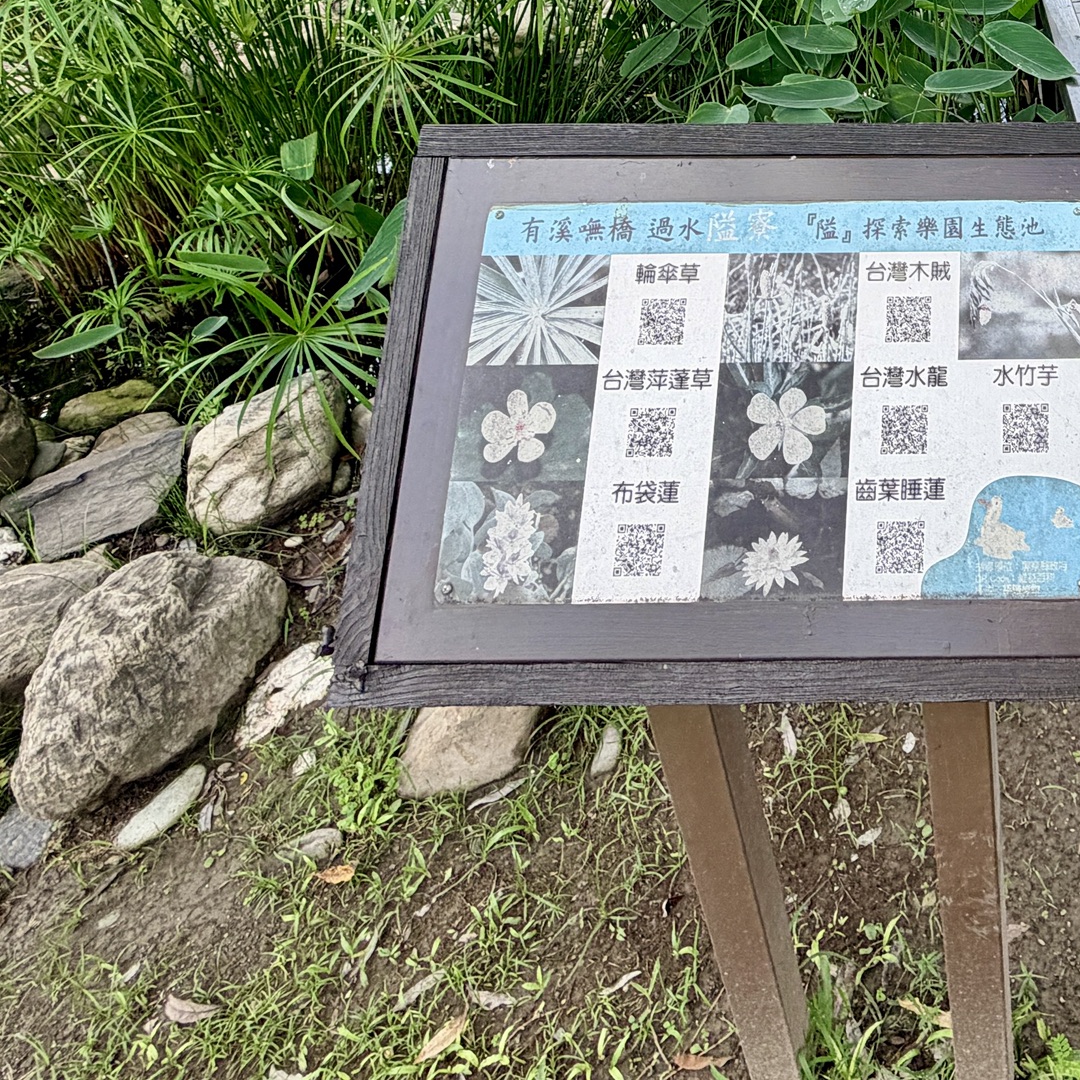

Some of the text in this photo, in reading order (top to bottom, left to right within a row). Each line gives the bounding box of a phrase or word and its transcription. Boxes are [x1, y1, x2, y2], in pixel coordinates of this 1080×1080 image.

[634, 262, 701, 285] 輪傘草
[865, 260, 951, 282] 台灣木賊
[601, 367, 714, 391] 台灣萍蓬草
[860, 364, 948, 388] 台灣水龍
[992, 363, 1059, 387] 水竹芋
[611, 479, 681, 505] 布袋蓮
[855, 476, 946, 502] 齒葉睡蓮
